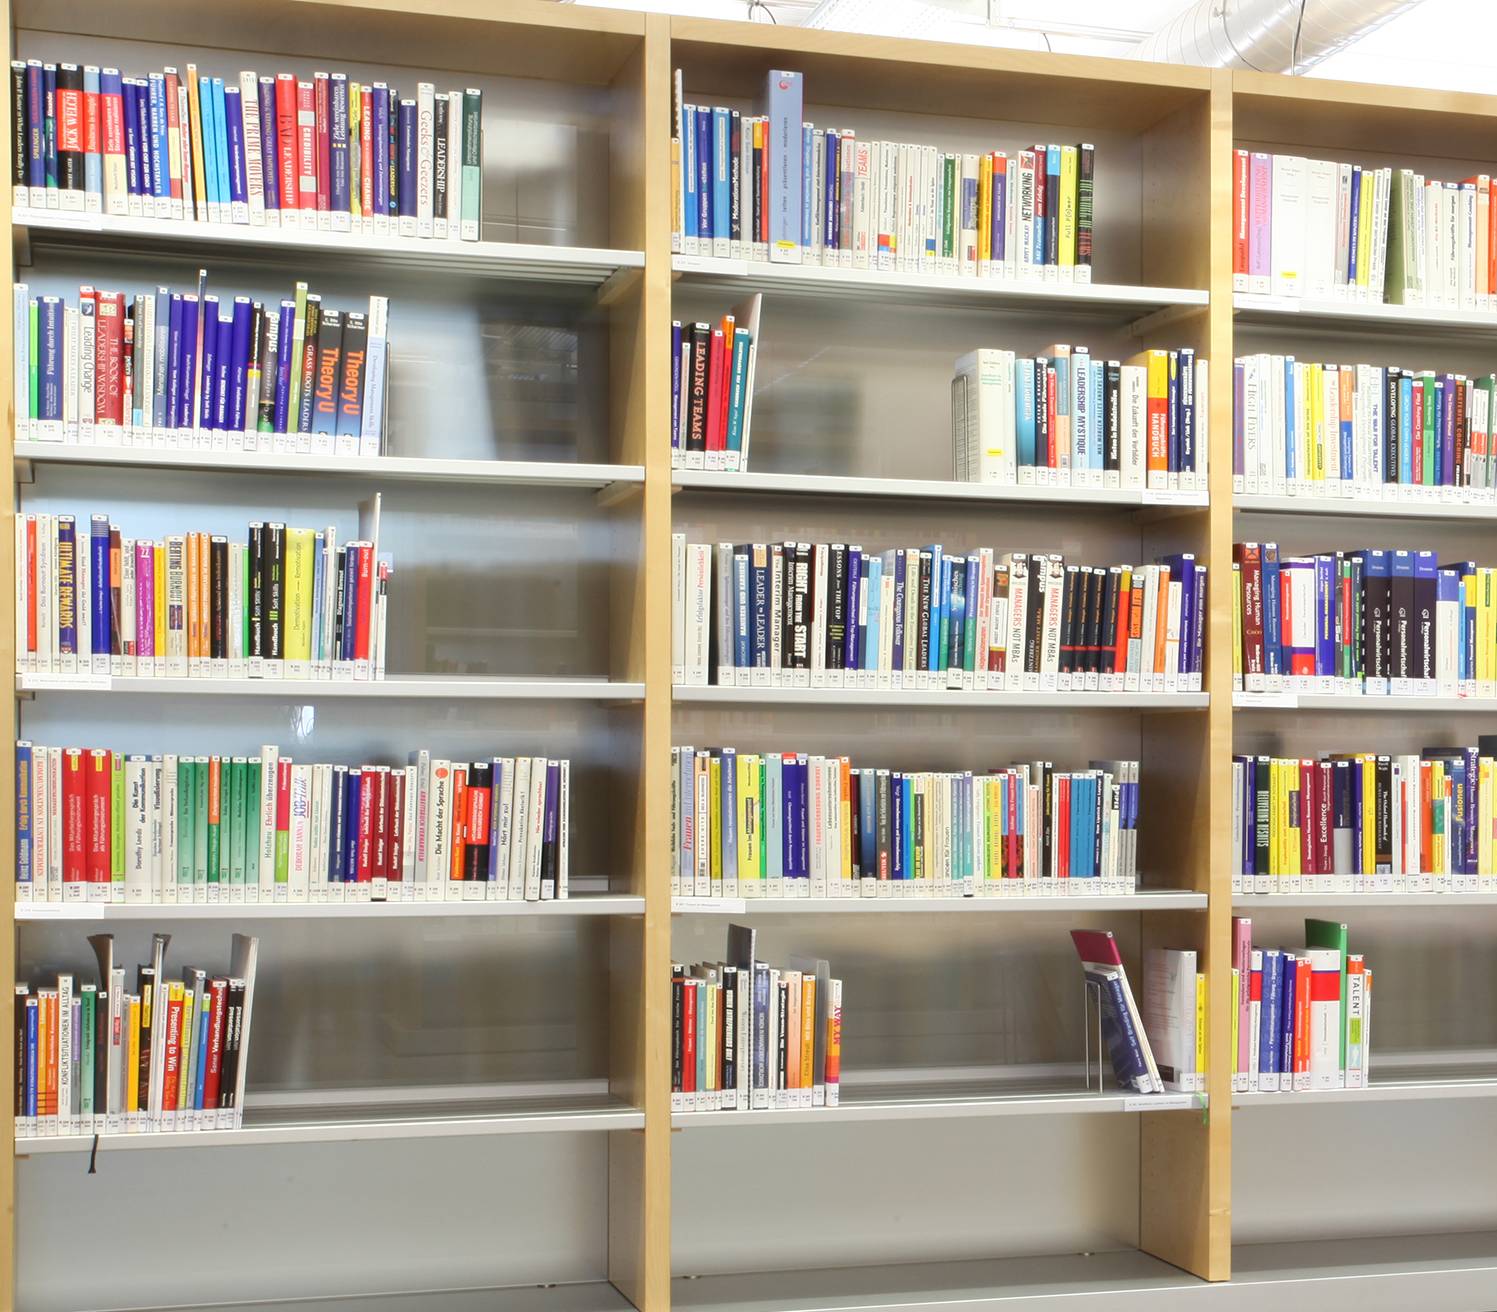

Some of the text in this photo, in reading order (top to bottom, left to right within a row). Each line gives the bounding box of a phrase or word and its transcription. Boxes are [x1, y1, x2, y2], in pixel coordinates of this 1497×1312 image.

[65, 92, 80, 150] JACK WELCH
[153, 150, 161, 194] HOCHSTAPLER
[245, 100, 262, 196] THE PRIME MOVERS
[303, 127, 312, 176] CREDIBILITY
[363, 105, 372, 210] LEADING CHANGE
[420, 110, 432, 205] Geeks Geezers
[437, 137, 446, 192] LEADERSHIP
[857, 148, 869, 178] TEAMS
[283, 147, 299, 204] LEADERSHIP
[1021, 173, 1033, 222] NETWORKING
[80, 326, 95, 393] Leading Change
[108, 337, 118, 397] THE BOOK OF
[316, 347, 339, 412] Theory U
[340, 350, 363, 415] Theory U
[691, 341, 705, 440] LEADING TEAMS
[1076, 368, 1086, 456] LEADERSHIP MYSTIQUE
[1131, 394, 1139, 404] Die
[1131, 405, 1139, 424] Zukunft
[1151, 413, 1159, 457] HANDBUCH
[1329, 387, 1338, 472] Leadership Investment
[59, 541, 74, 628] ULTIMATE REWARDS
[361, 548, 370, 578] Burn-out
[796, 563, 808, 594] RIGHT
[294, 593, 303, 631] Demotivation
[755, 569, 766, 649] LEADER LEADER
[786, 586, 794, 626] Management
[1251, 570, 1262, 626] Managing Human
[270, 623, 279, 656] Handbuch
[772, 609, 781, 653] Manager
[794, 624, 807, 658] START
[1046, 587, 1058, 662] MANAGERS NOT MBAs
[139, 768, 147, 813] Kommunikation
[266, 762, 275, 802] überzeugen
[1456, 783, 1464, 822] Fusionen
[435, 781, 446, 855] Die Macht der Sprache
[683, 816, 693, 850] Frauen
[1257, 791, 1268, 847] DELIVERING RESULTS
[1319, 803, 1328, 843] Excellence
[136, 846, 145, 870] Dorothy
[1352, 976, 1361, 1016] TALENT
[61, 986, 71, 1085] KONFLIKTSITUATIONEN IM ALLTAG
[167, 1006, 180, 1071] Presenting to Win
[833, 1005, 842, 1045] MY WAY
